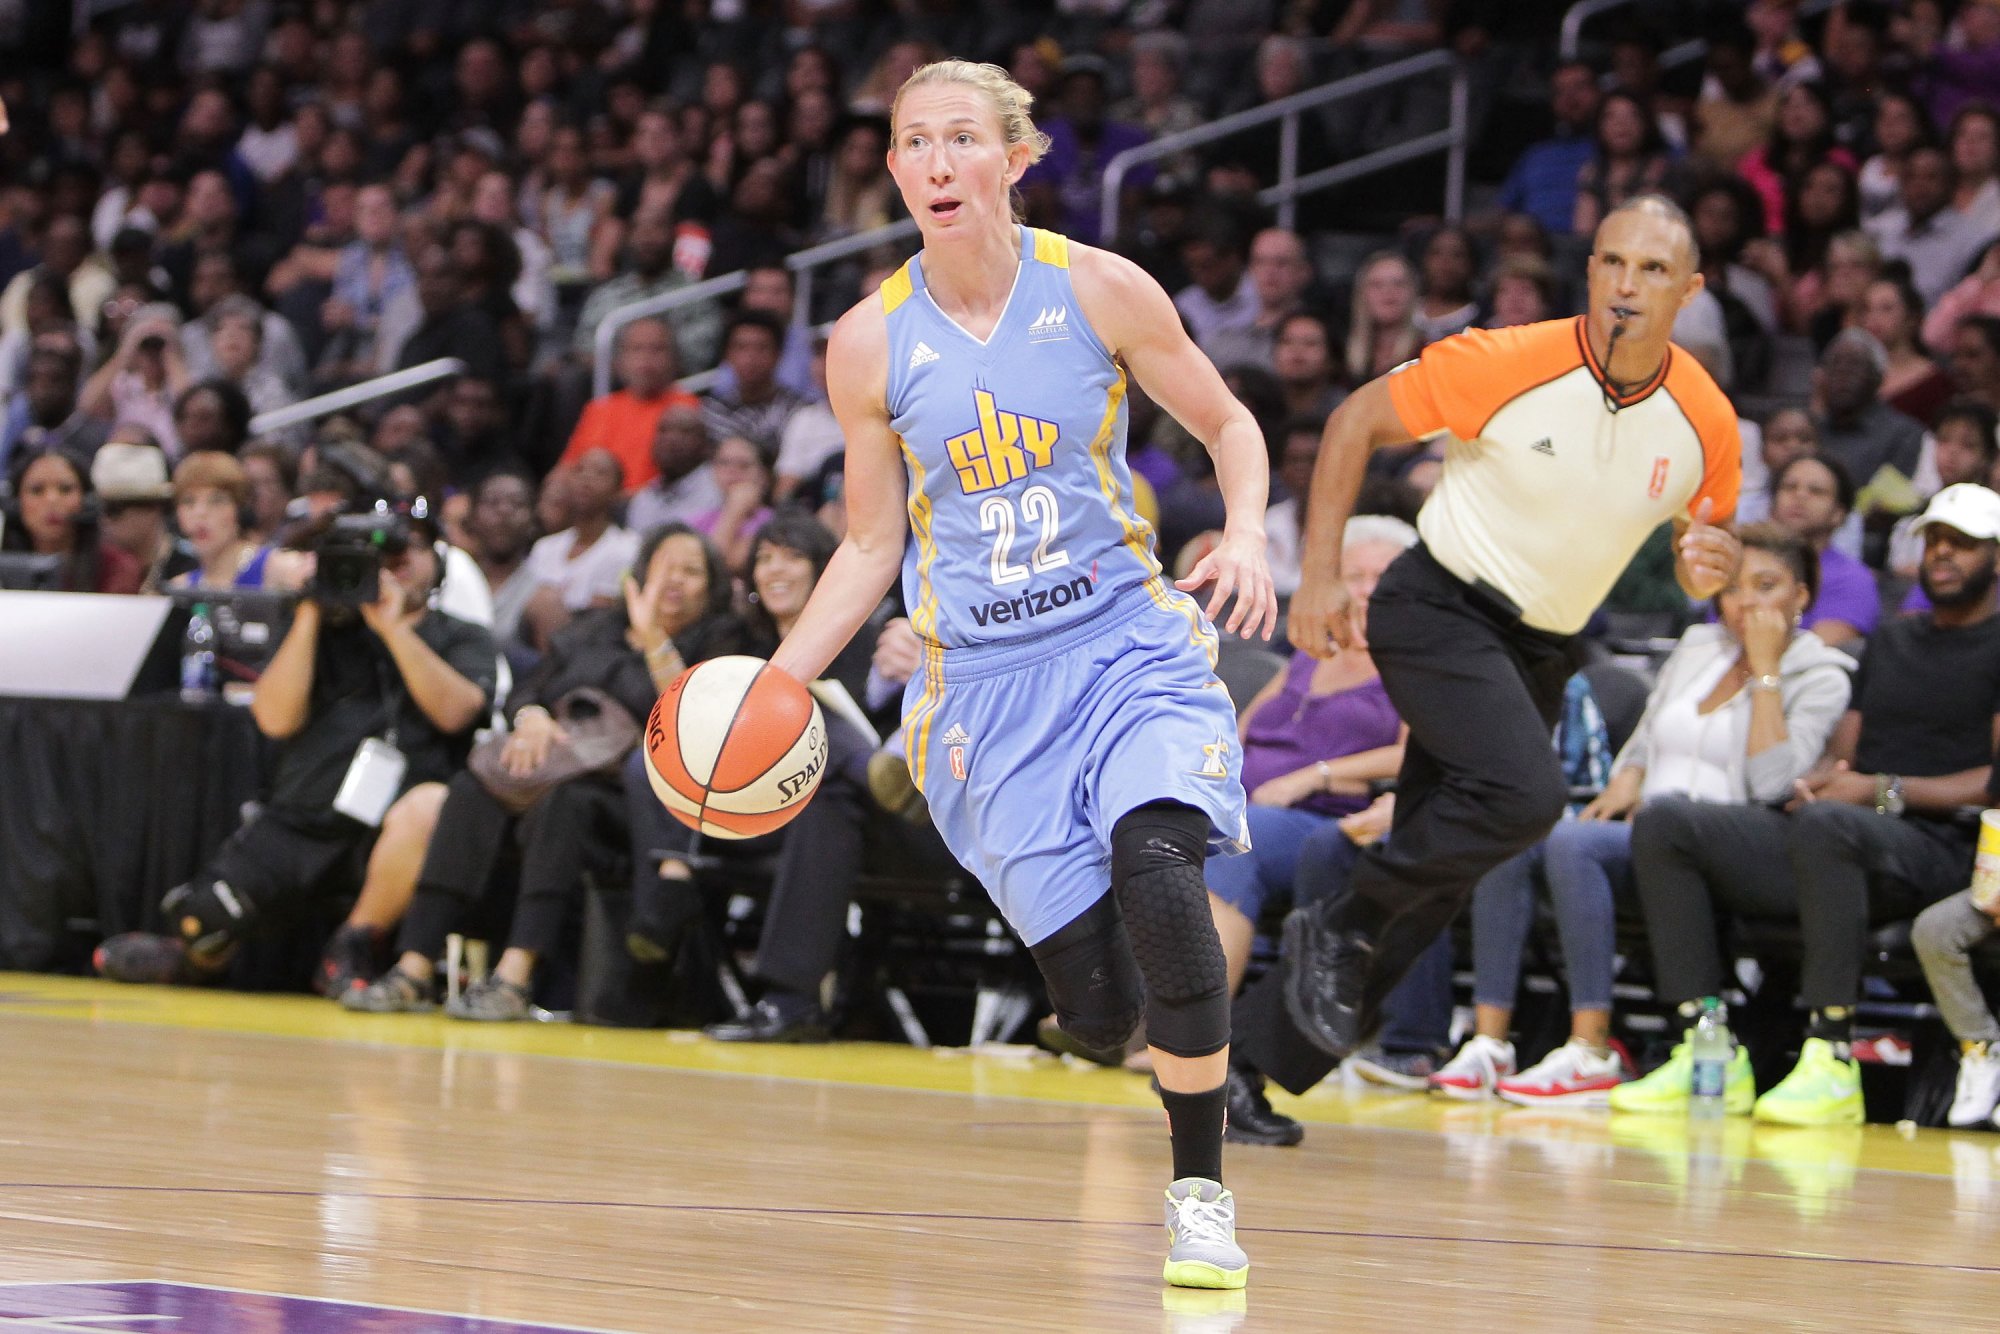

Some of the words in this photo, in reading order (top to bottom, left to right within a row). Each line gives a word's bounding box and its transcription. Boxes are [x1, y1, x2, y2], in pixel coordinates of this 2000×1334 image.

[980, 485, 1070, 586] 22
[969, 575, 1094, 627] verizon
[777, 741, 827, 804] SPALD
